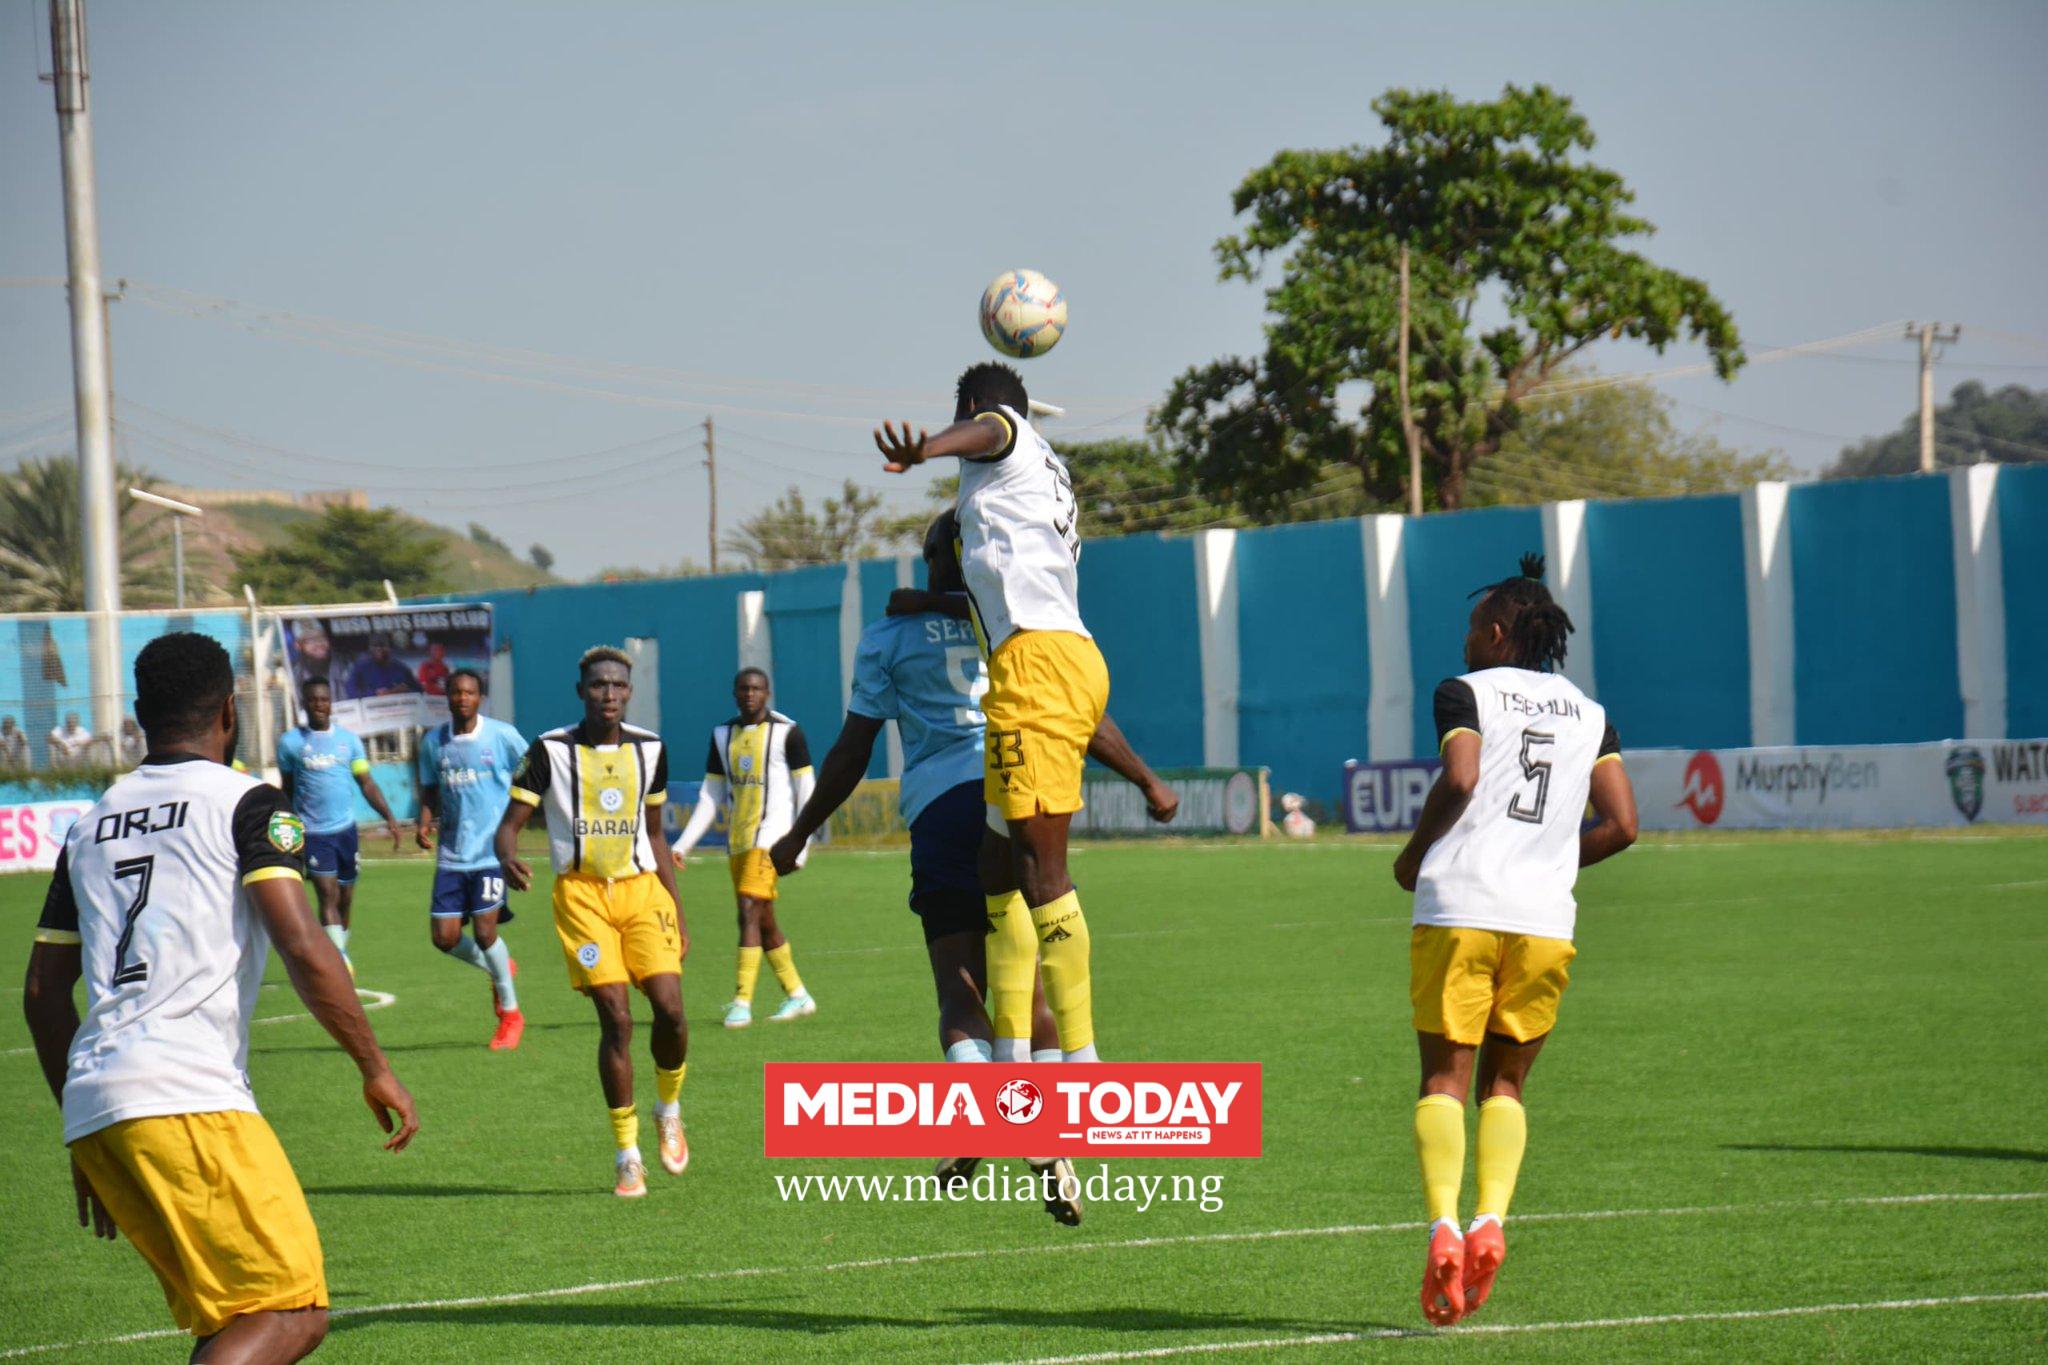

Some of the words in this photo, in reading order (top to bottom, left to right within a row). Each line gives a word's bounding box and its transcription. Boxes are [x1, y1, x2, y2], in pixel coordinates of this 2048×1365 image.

[1506, 727, 1556, 825] 5
[1992, 742, 2048, 781] WAT
[95, 801, 189, 845] ORJI
[481, 876, 505, 902] 19
[654, 909, 677, 933] 14
